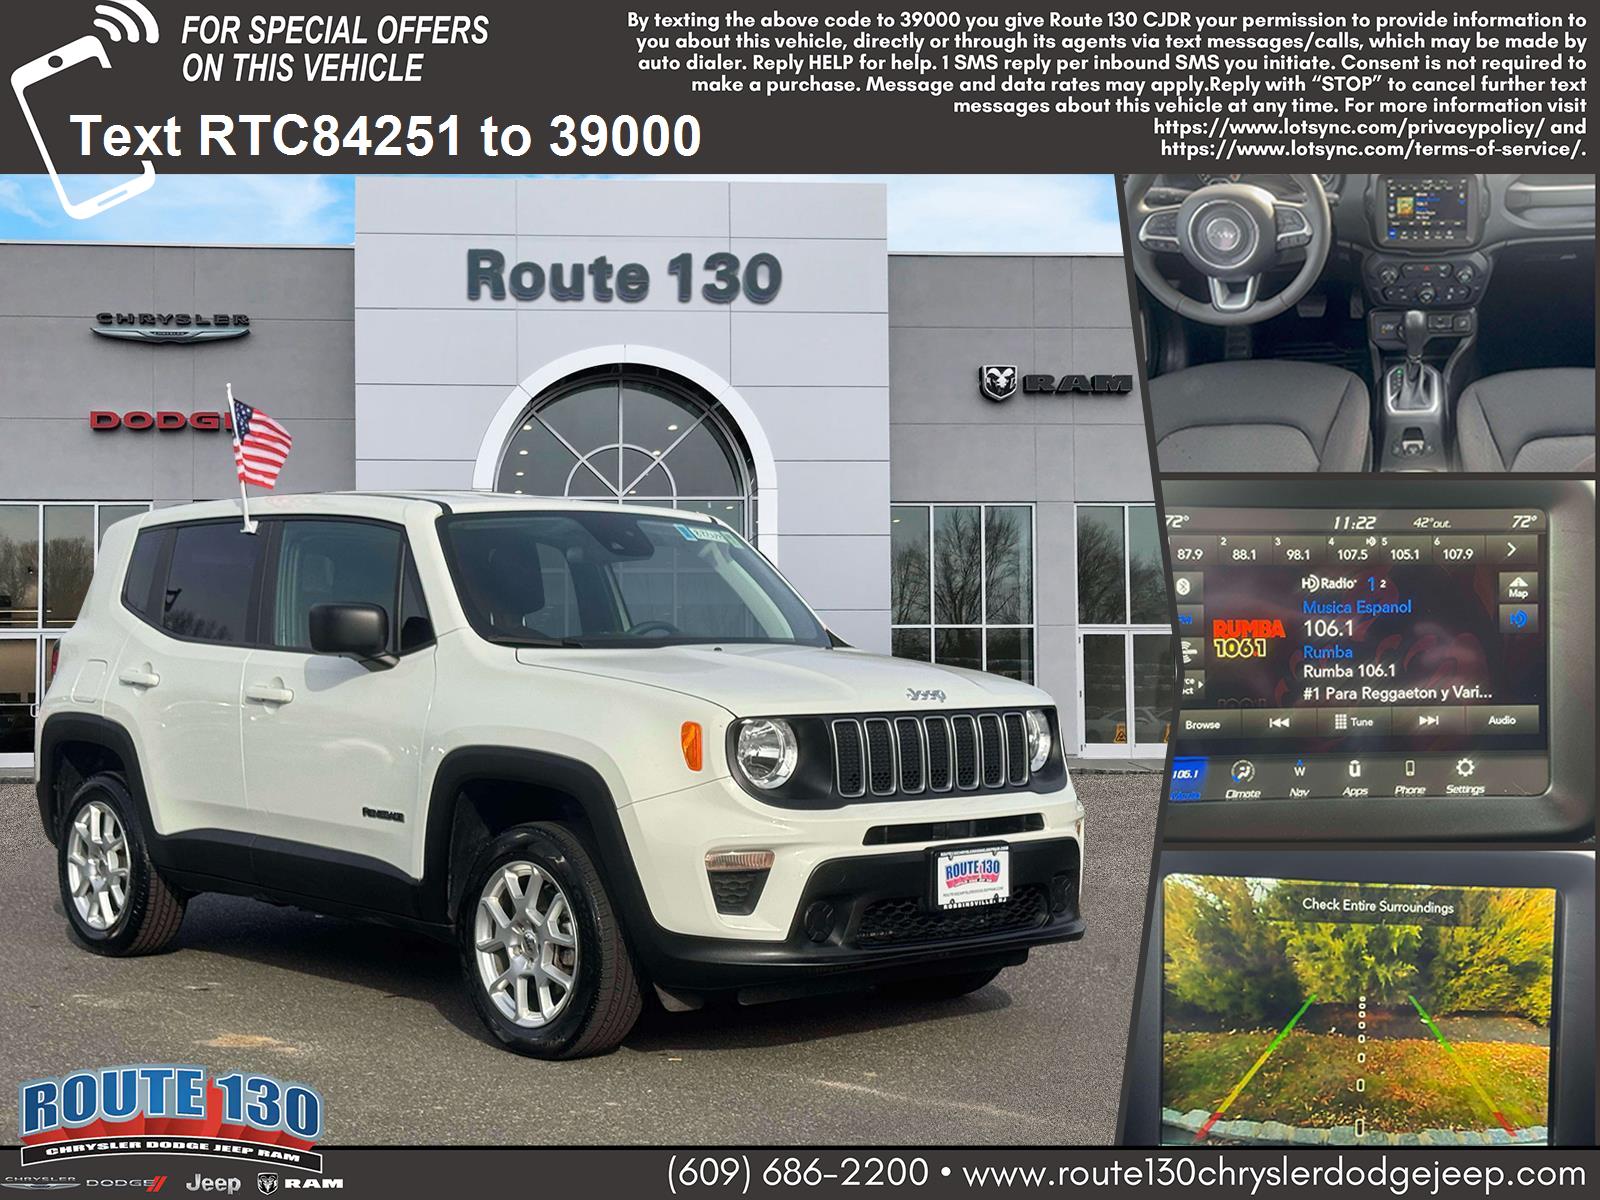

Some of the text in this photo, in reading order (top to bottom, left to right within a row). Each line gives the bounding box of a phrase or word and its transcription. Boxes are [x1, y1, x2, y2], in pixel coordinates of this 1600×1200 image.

[467, 248, 783, 304] Route 130
[96, 312, 250, 326] CHRYSLER
[1023, 374, 1133, 394] RAM
[90, 411, 231, 430] DODG
[1334, 515, 1538, 530] 11:22 72°
[1177, 548, 1474, 561] 87.9 88.1 98.1 107.5 105.1 107.9
[1321, 576, 1356, 590] Radio
[1508, 589, 1529, 600] Map
[1303, 599, 1412, 617] Musica Espanol
[1213, 619, 1287, 639] RUMBA
[1303, 619, 1354, 637] 106.1
[1303, 644, 1353, 659] Rumba
[1303, 663, 1396, 678] Rumba 106.1
[1303, 686, 1320, 701] #1
[1326, 686, 1358, 701] Para
[1362, 685, 1437, 703] Reggaeton
[1440, 688, 1450, 702] y
[1185, 715, 1517, 731] Browse Tune Audio
[1172, 769, 1199, 780] 106.1
[1225, 783, 1486, 799] Climate Nav Apps Phone Settings
[945, 859, 1001, 881] ROUTE 130
[1302, 897, 1455, 916] Check Entire Surroundings
